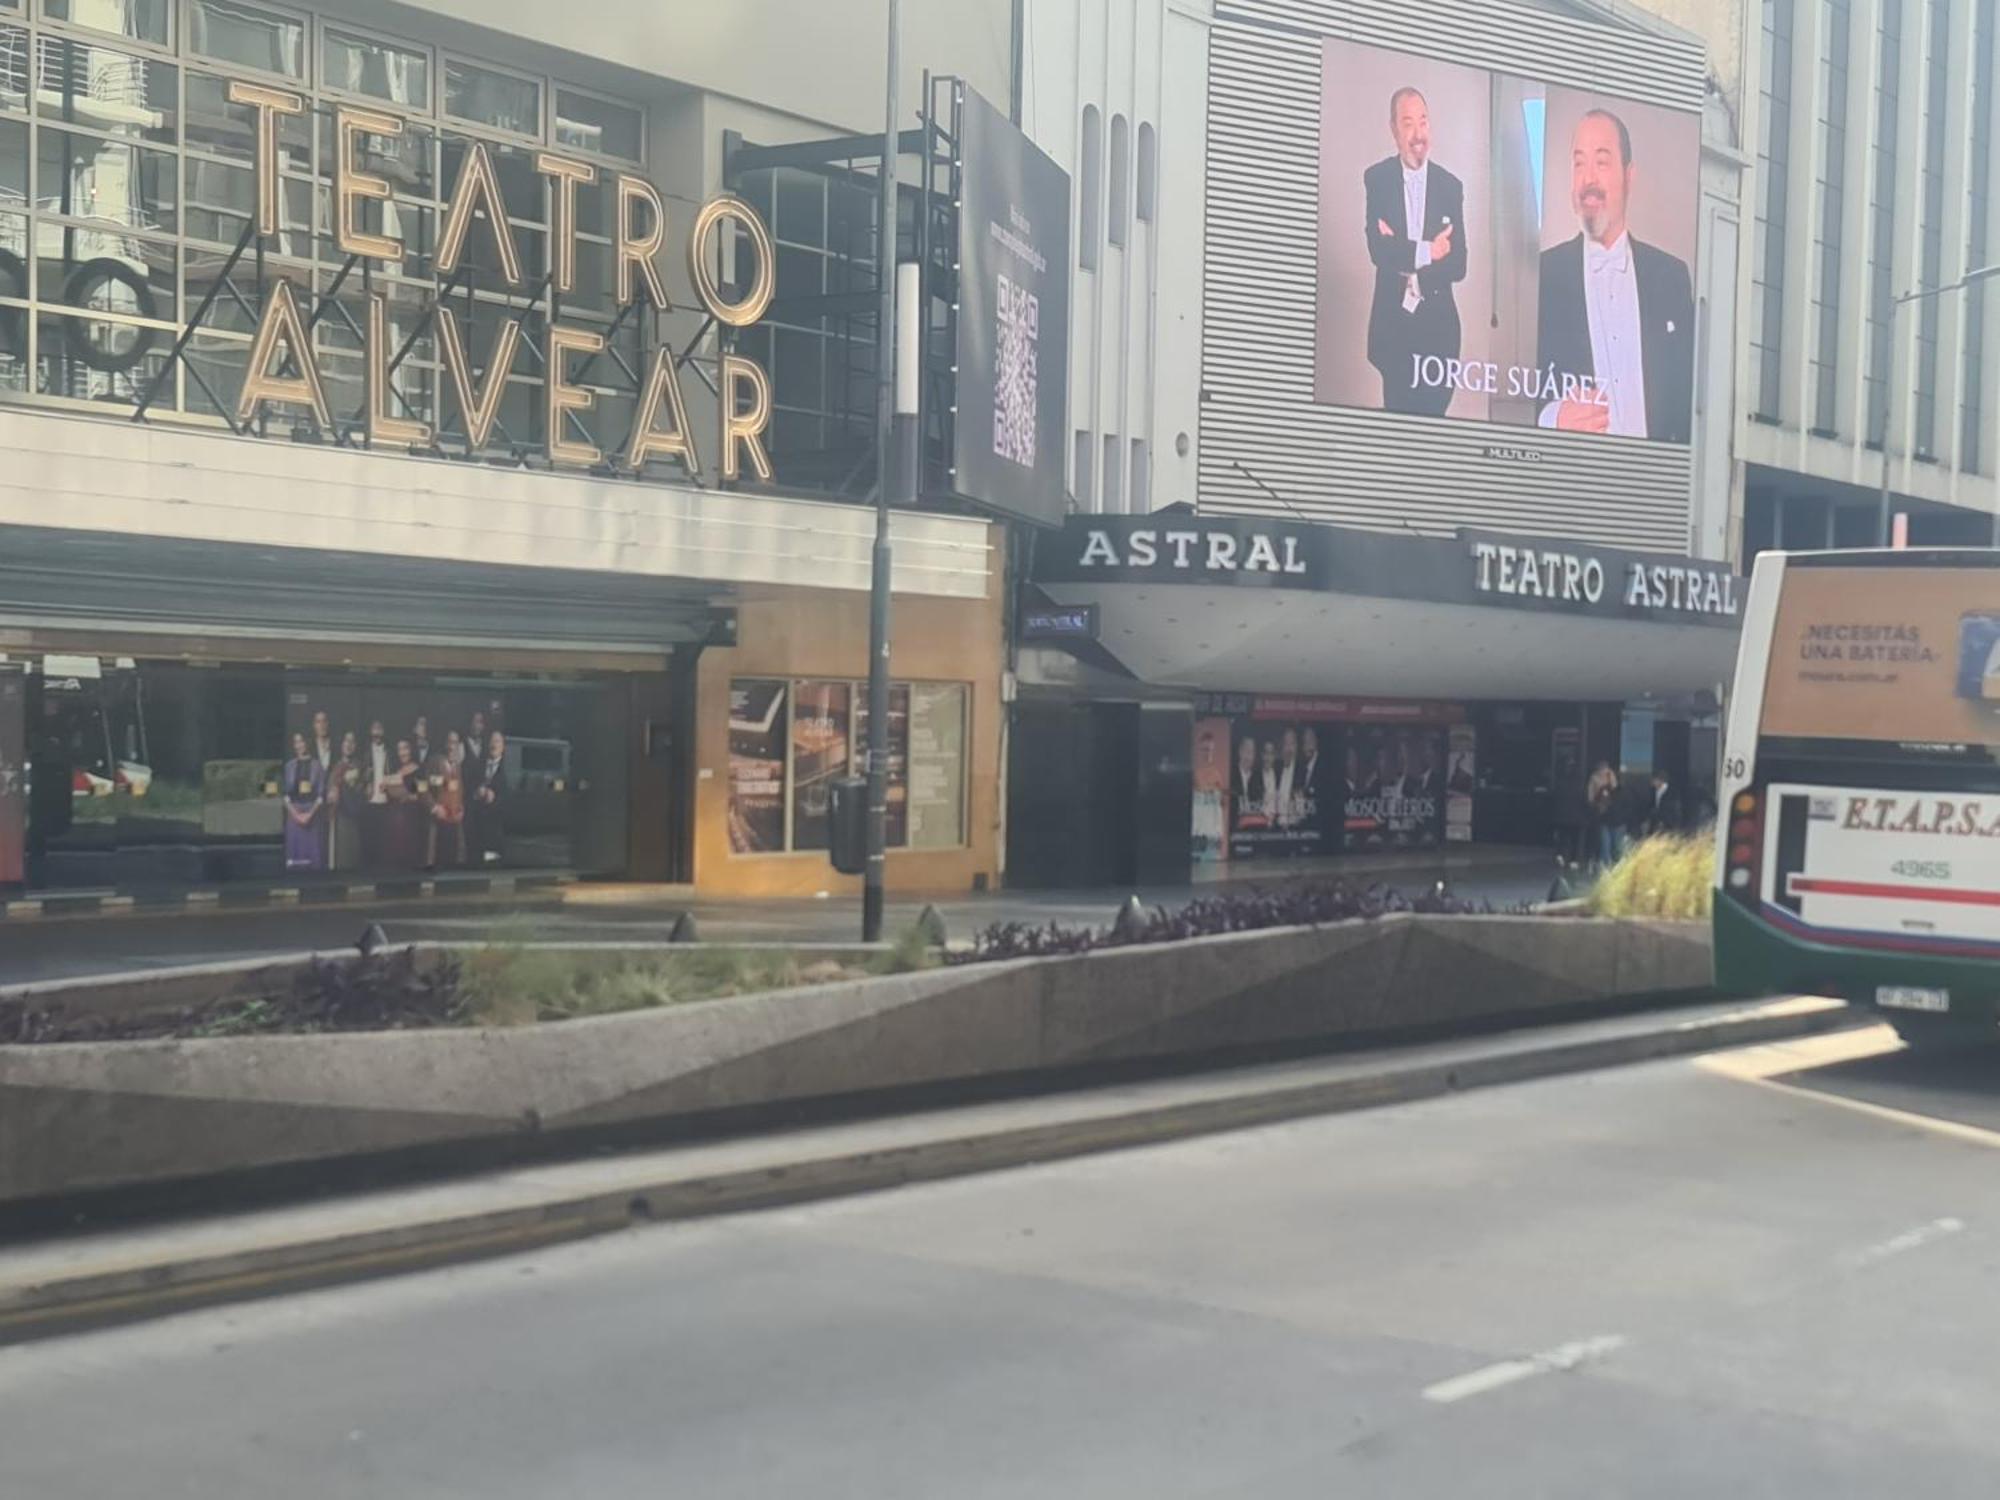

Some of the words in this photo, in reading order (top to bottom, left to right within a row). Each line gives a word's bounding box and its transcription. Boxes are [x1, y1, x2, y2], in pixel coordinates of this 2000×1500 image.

[225, 79, 776, 326] TEATRO
[236, 279, 774, 481] ALVEAR
[1411, 354, 1498, 393] JORGE
[1508, 363, 1608, 405] SUÁREZ
[1080, 531, 1306, 574] ASTRAL
[1475, 544, 1605, 604] TEATRO
[1625, 563, 1737, 615] ASTRAL
[1801, 644, 1842, 661] UNA
